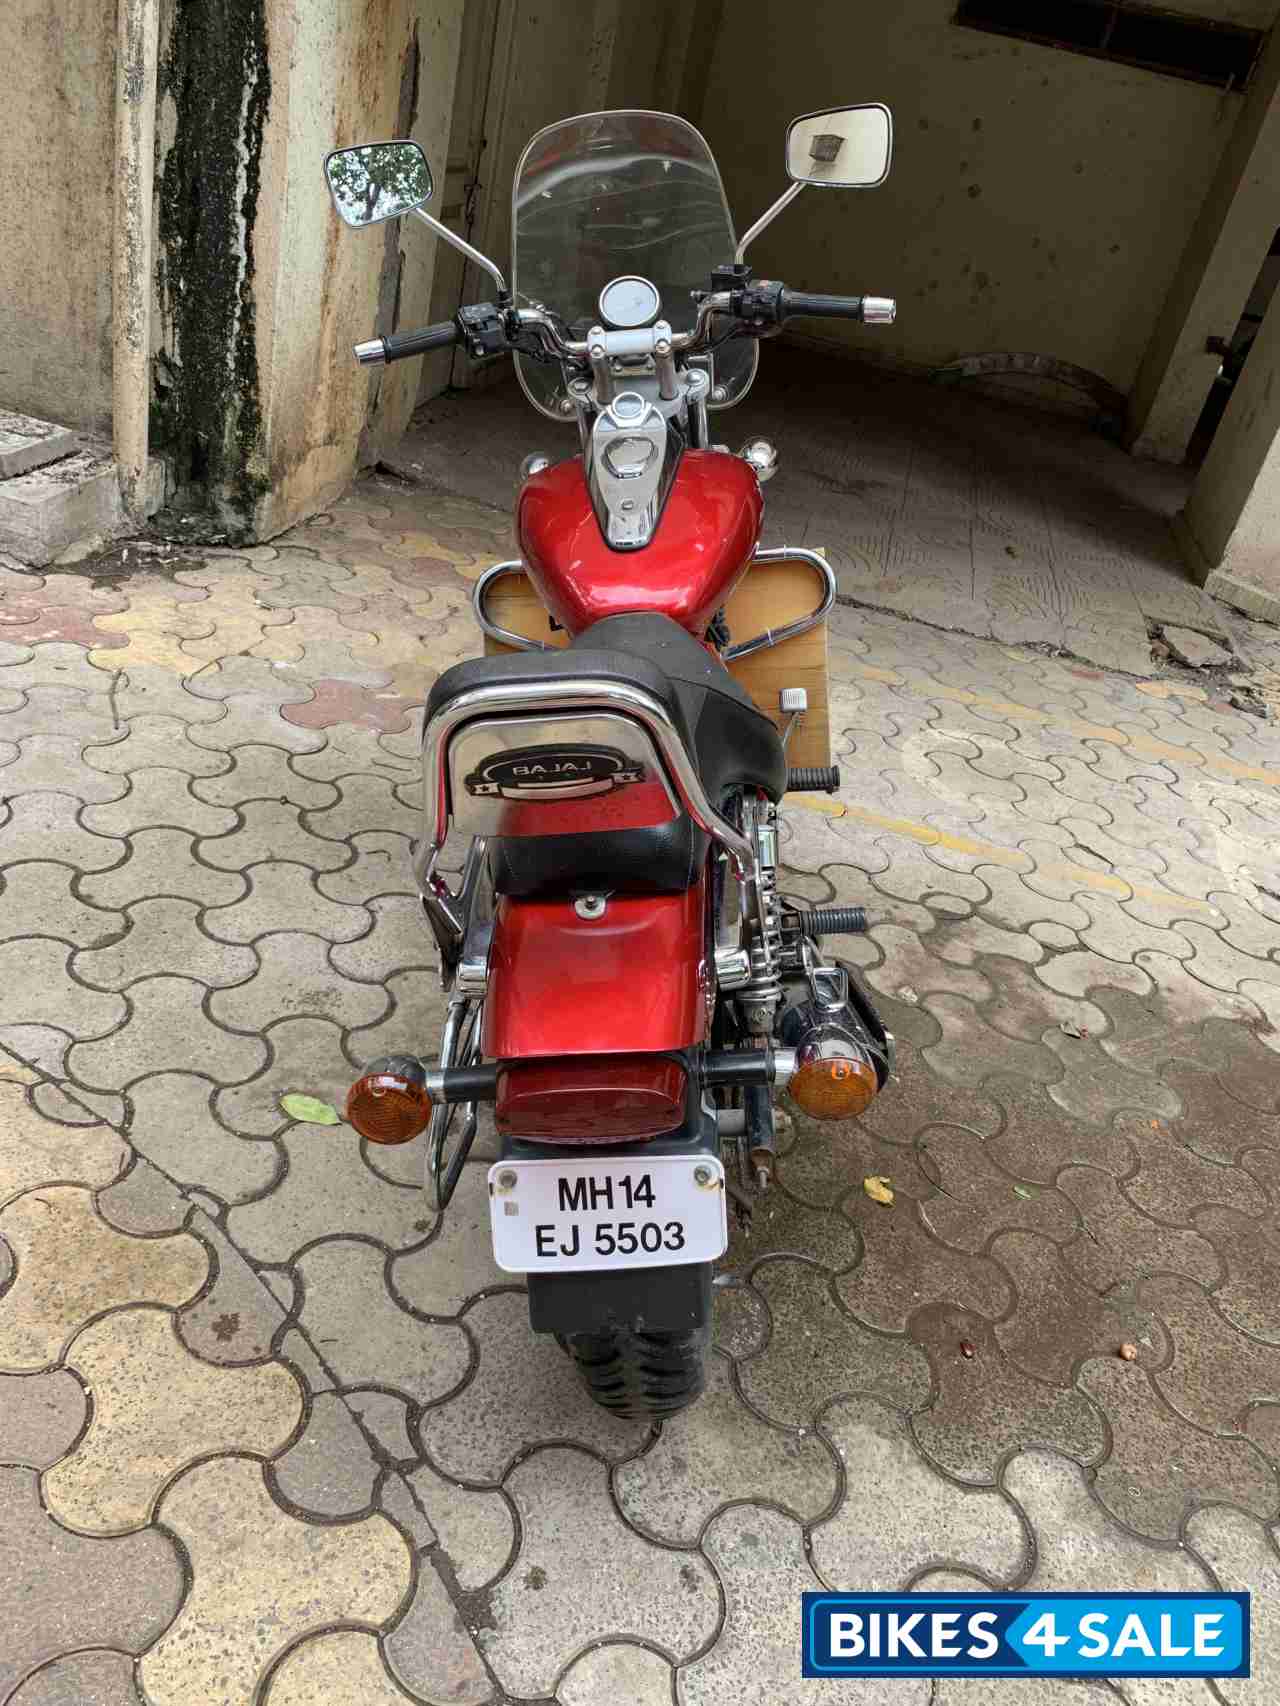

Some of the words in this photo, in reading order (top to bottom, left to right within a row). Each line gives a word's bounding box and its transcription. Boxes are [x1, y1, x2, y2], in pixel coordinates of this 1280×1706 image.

[512, 760, 593, 776] BAJAJ
[557, 1174, 656, 1212] MH14
[535, 1224, 580, 1257] EJ
[595, 1221, 686, 1256] 5503
